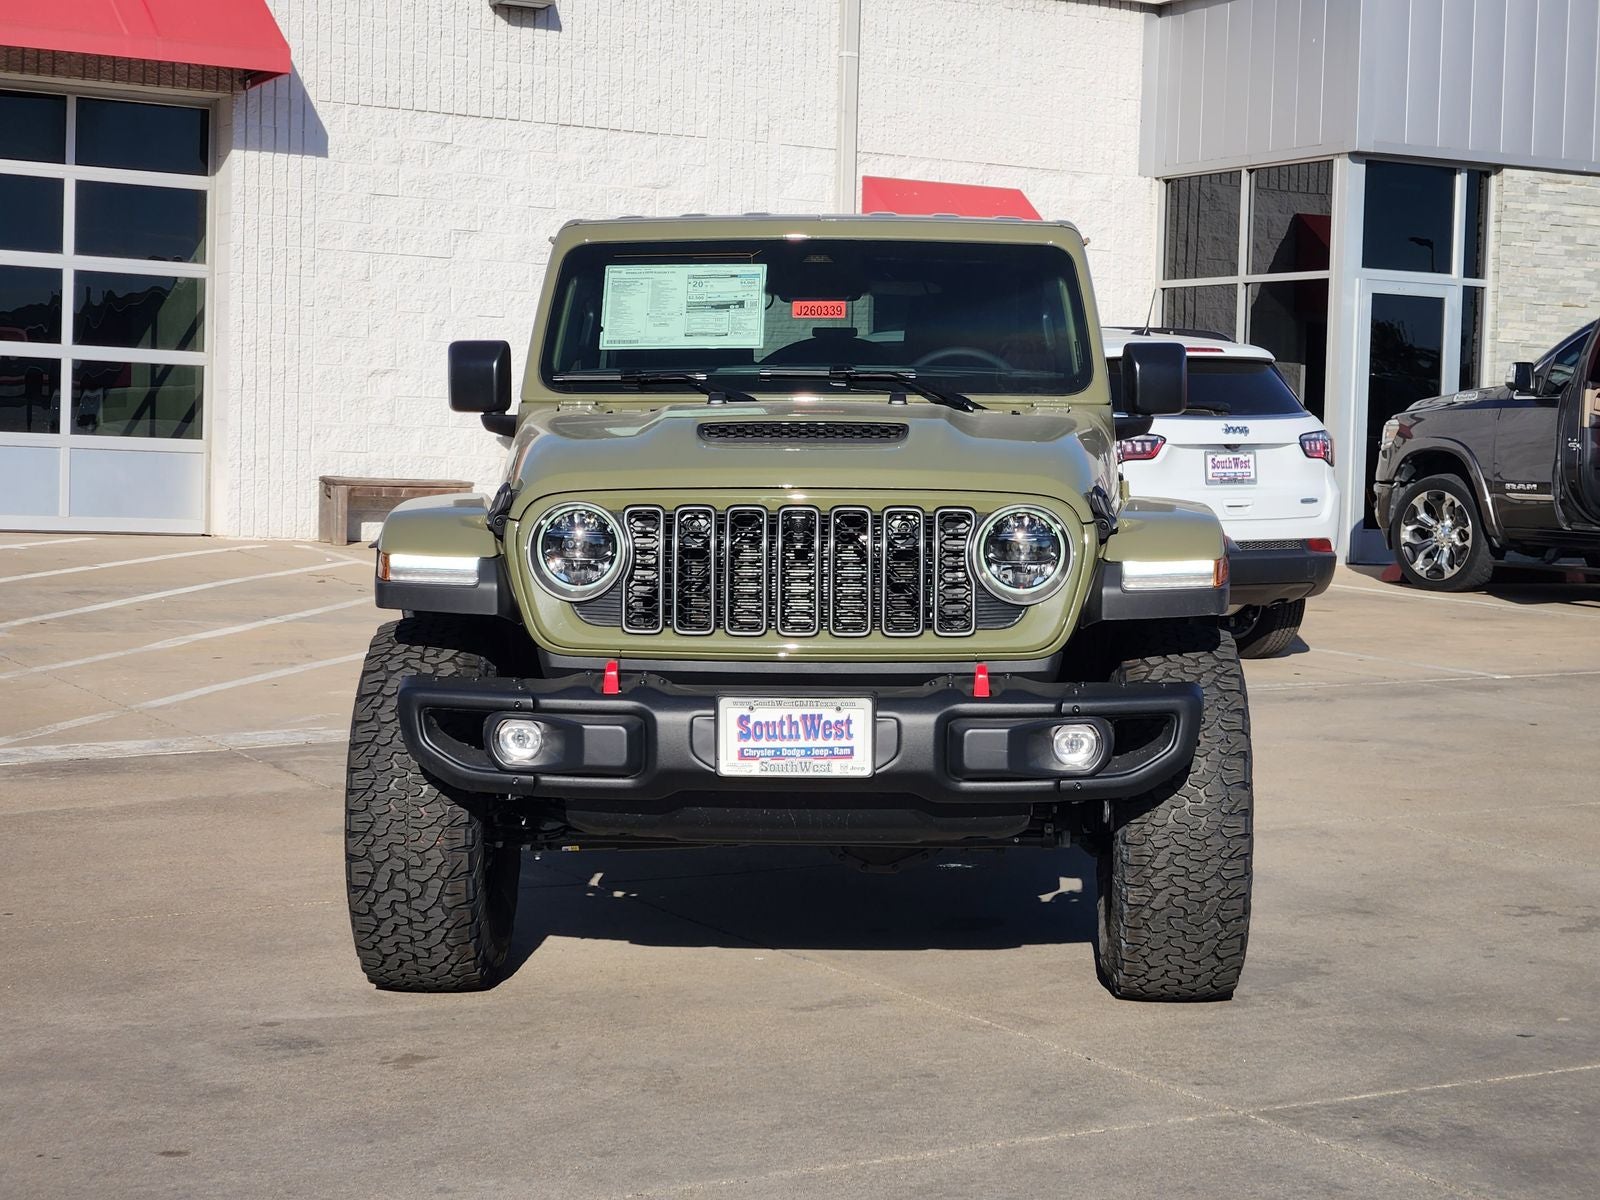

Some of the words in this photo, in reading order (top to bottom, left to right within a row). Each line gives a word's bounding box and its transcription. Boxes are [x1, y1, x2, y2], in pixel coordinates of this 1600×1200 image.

[692, 280, 704, 288] 20
[796, 305, 843, 316] J260339
[1211, 457, 1251, 470] SouthWest
[1505, 483, 1538, 491] RAM
[737, 713, 855, 742] SouthWest
[743, 747, 775, 757] Chrysler
[781, 747, 806, 757] Dodge
[811, 747, 829, 757] Jeep
[833, 747, 851, 756] Ram
[760, 761, 833, 774] SouthWest
